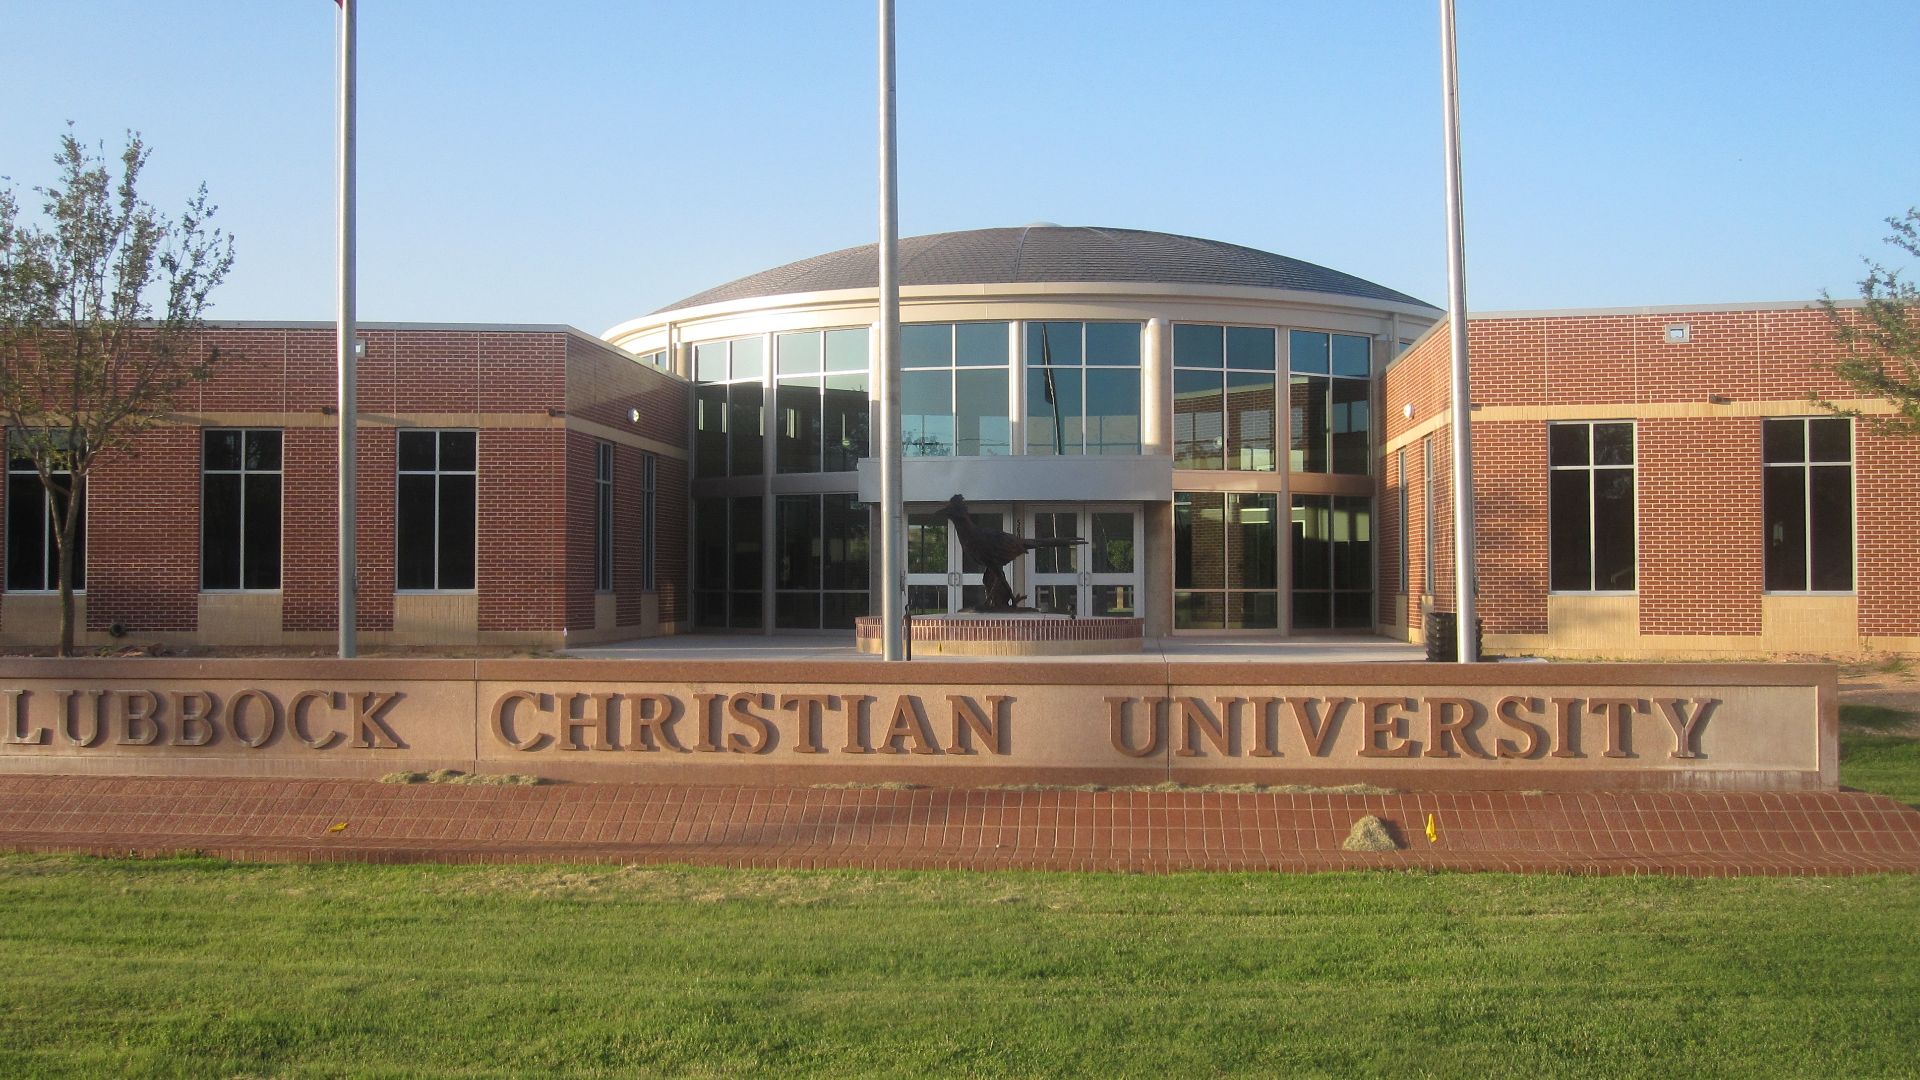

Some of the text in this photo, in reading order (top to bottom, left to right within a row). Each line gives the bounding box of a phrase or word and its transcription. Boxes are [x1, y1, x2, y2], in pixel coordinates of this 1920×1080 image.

[3, 689, 1718, 759] LUBBOCK CHRISTIAN UNIVERSITY
